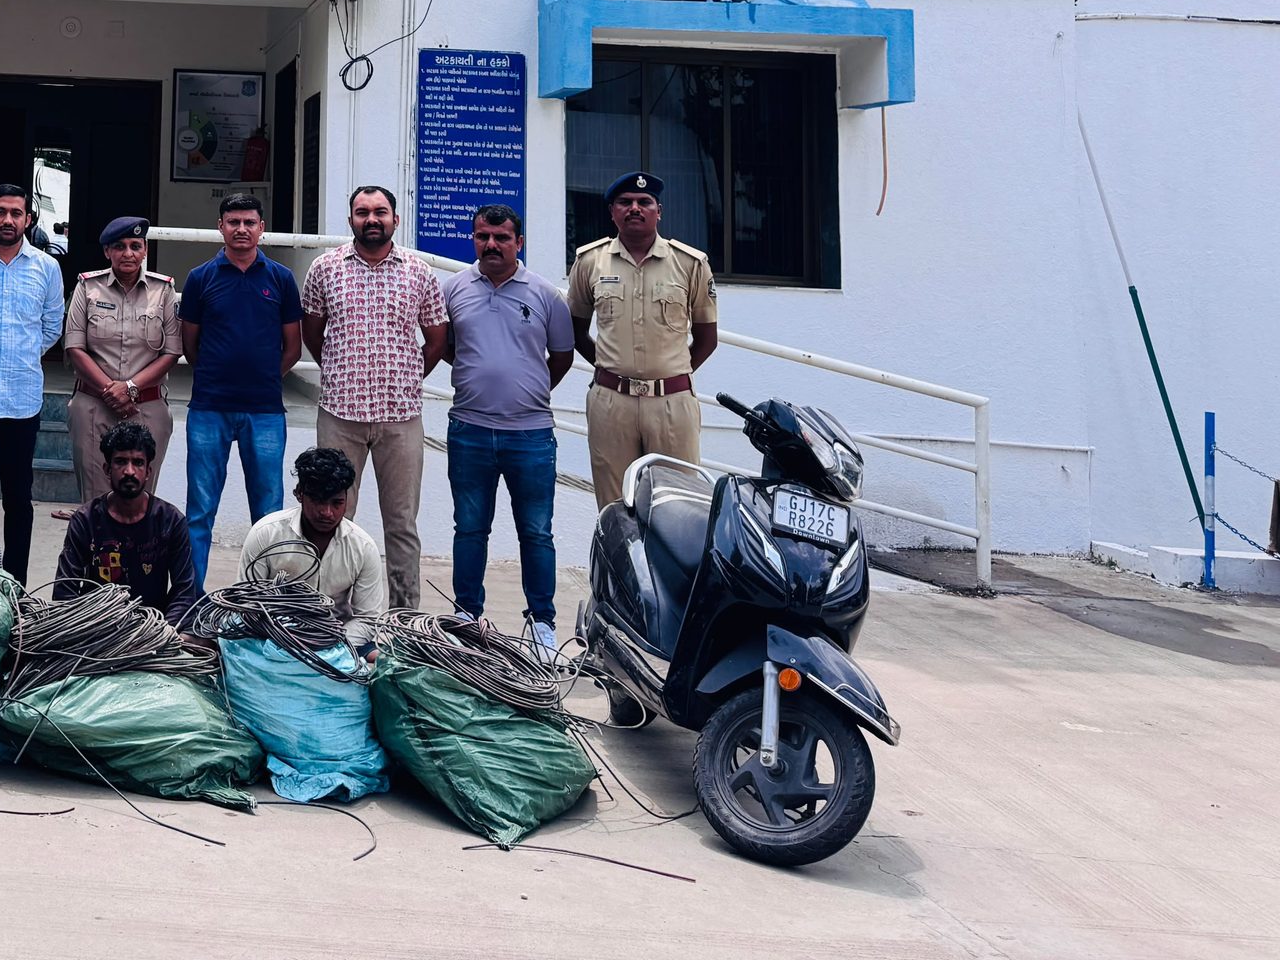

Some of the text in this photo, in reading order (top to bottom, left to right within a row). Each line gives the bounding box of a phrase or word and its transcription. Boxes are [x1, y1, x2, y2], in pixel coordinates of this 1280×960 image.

[435, 54, 473, 66] અટકાયતી
[476, 57, 487, 66] ના
[789, 496, 835, 521] GJ17C
[788, 511, 834, 537] R8226
[793, 529, 830, 544] Downtown
